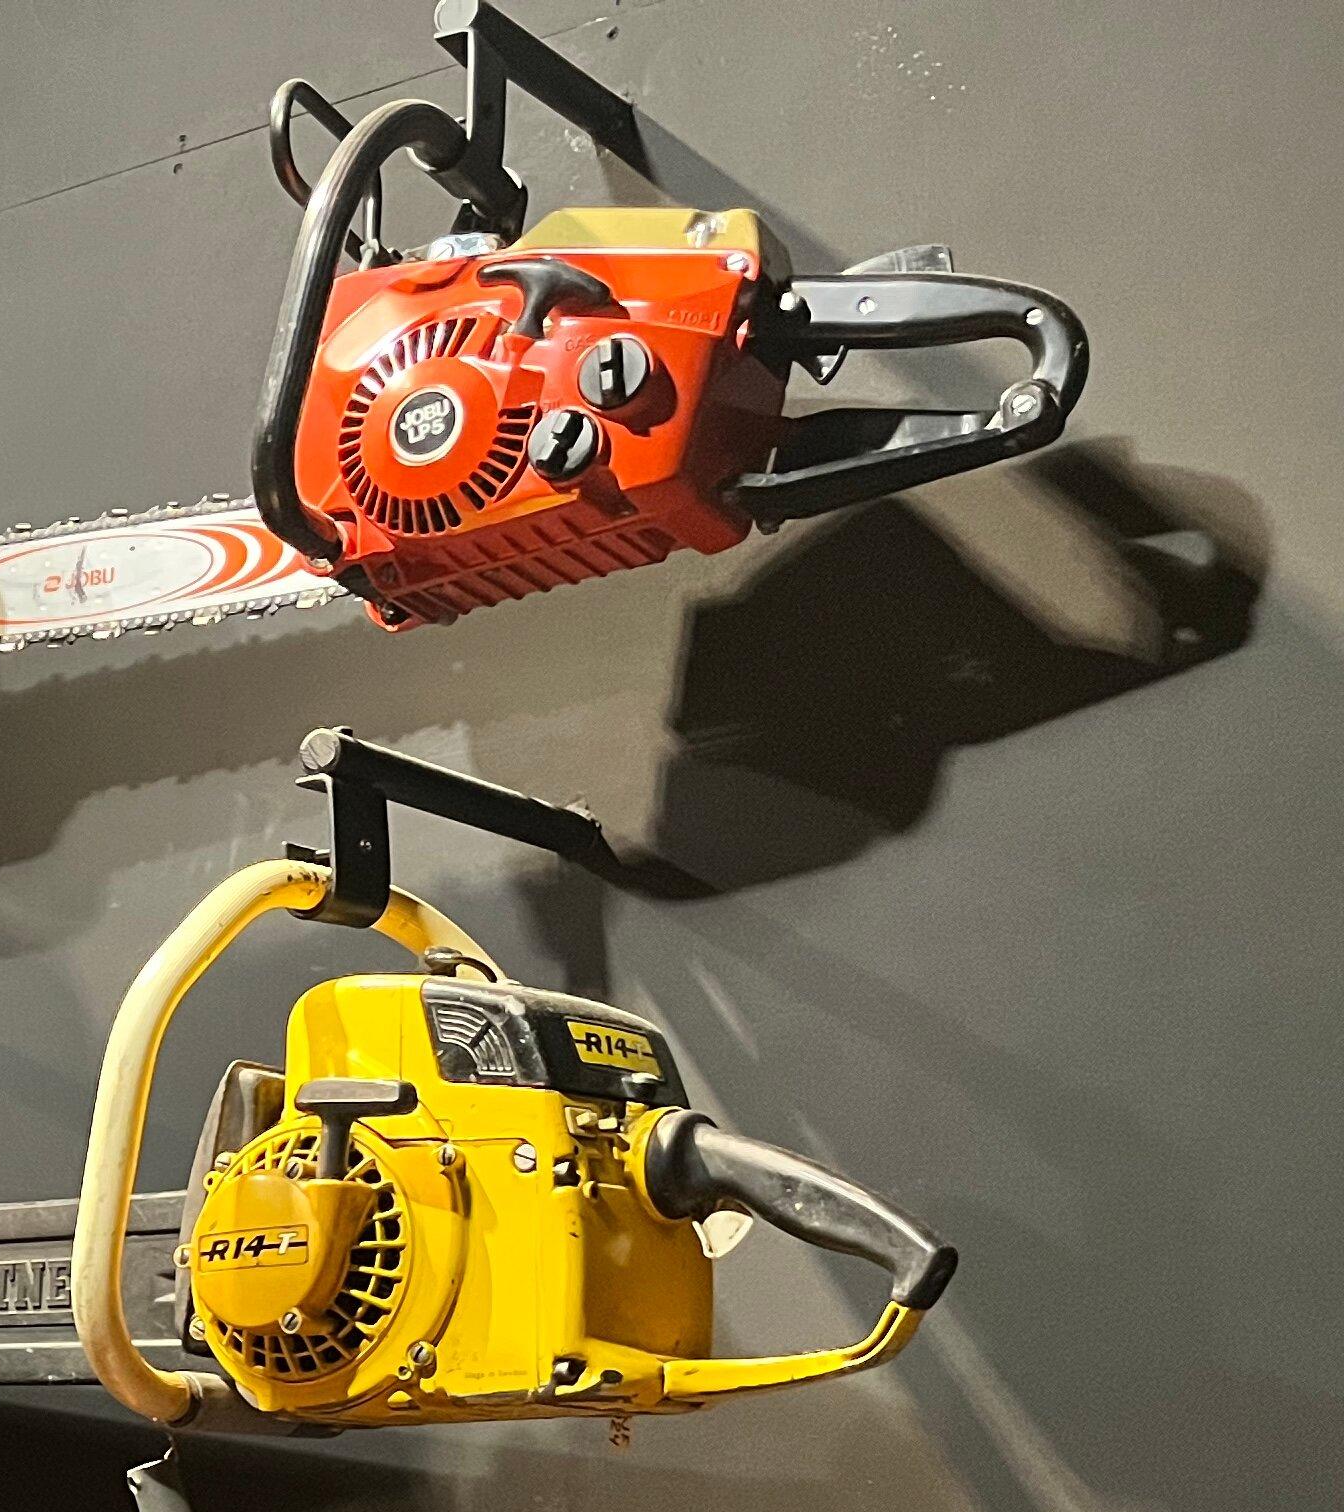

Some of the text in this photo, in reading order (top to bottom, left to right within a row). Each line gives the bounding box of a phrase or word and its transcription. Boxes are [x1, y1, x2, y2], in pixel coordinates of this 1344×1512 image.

[399, 398, 450, 431] JOBU
[65, 567, 115, 589] JOBU
[206, 1234, 266, 1263] R14
